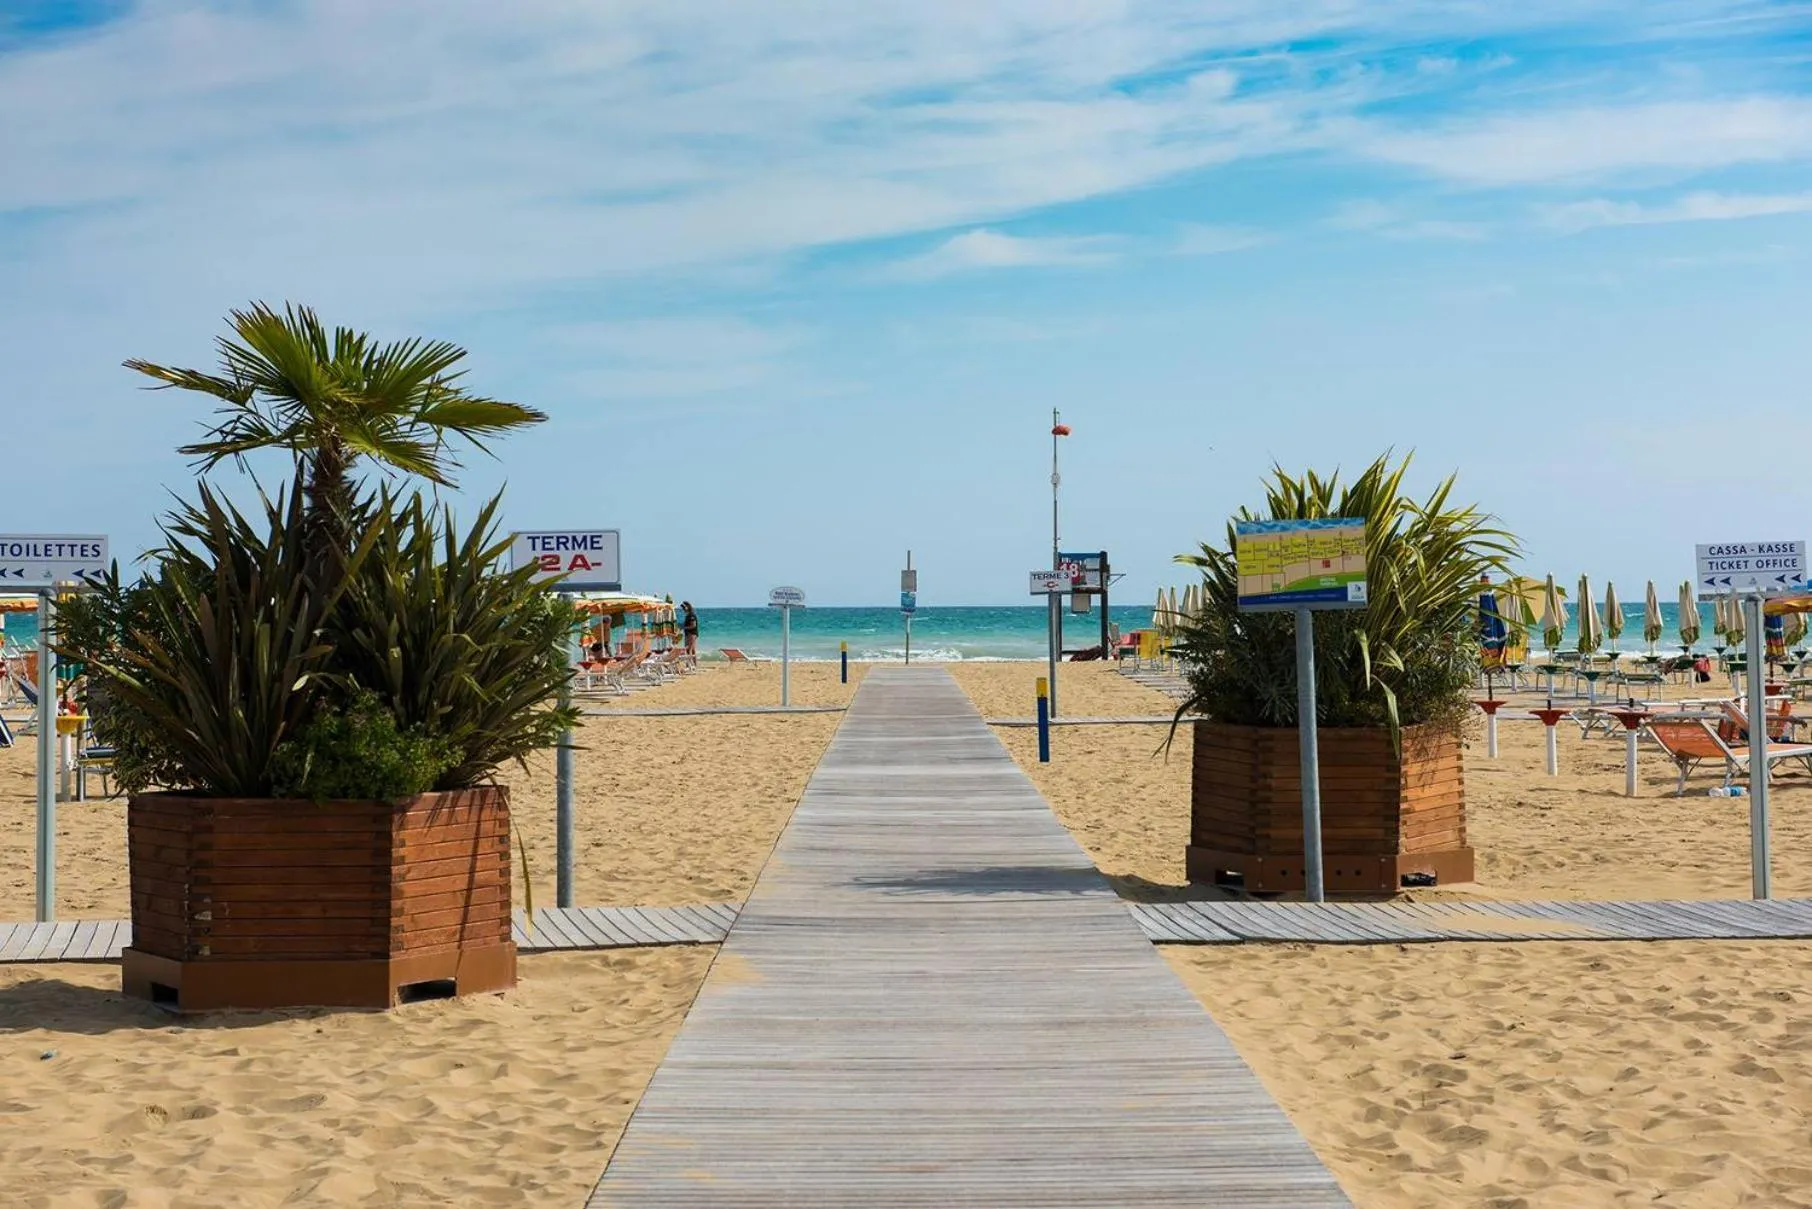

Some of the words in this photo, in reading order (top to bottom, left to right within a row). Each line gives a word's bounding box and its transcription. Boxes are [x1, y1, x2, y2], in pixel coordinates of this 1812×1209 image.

[527, 535, 603, 551] TERME
[1709, 545, 1747, 556] CASSA
[1758, 543, 1796, 554] KASSE
[0, 543, 101, 557] TOILETTES
[1708, 559, 1749, 571] TICKET
[1756, 558, 1797, 570] OFFICE
